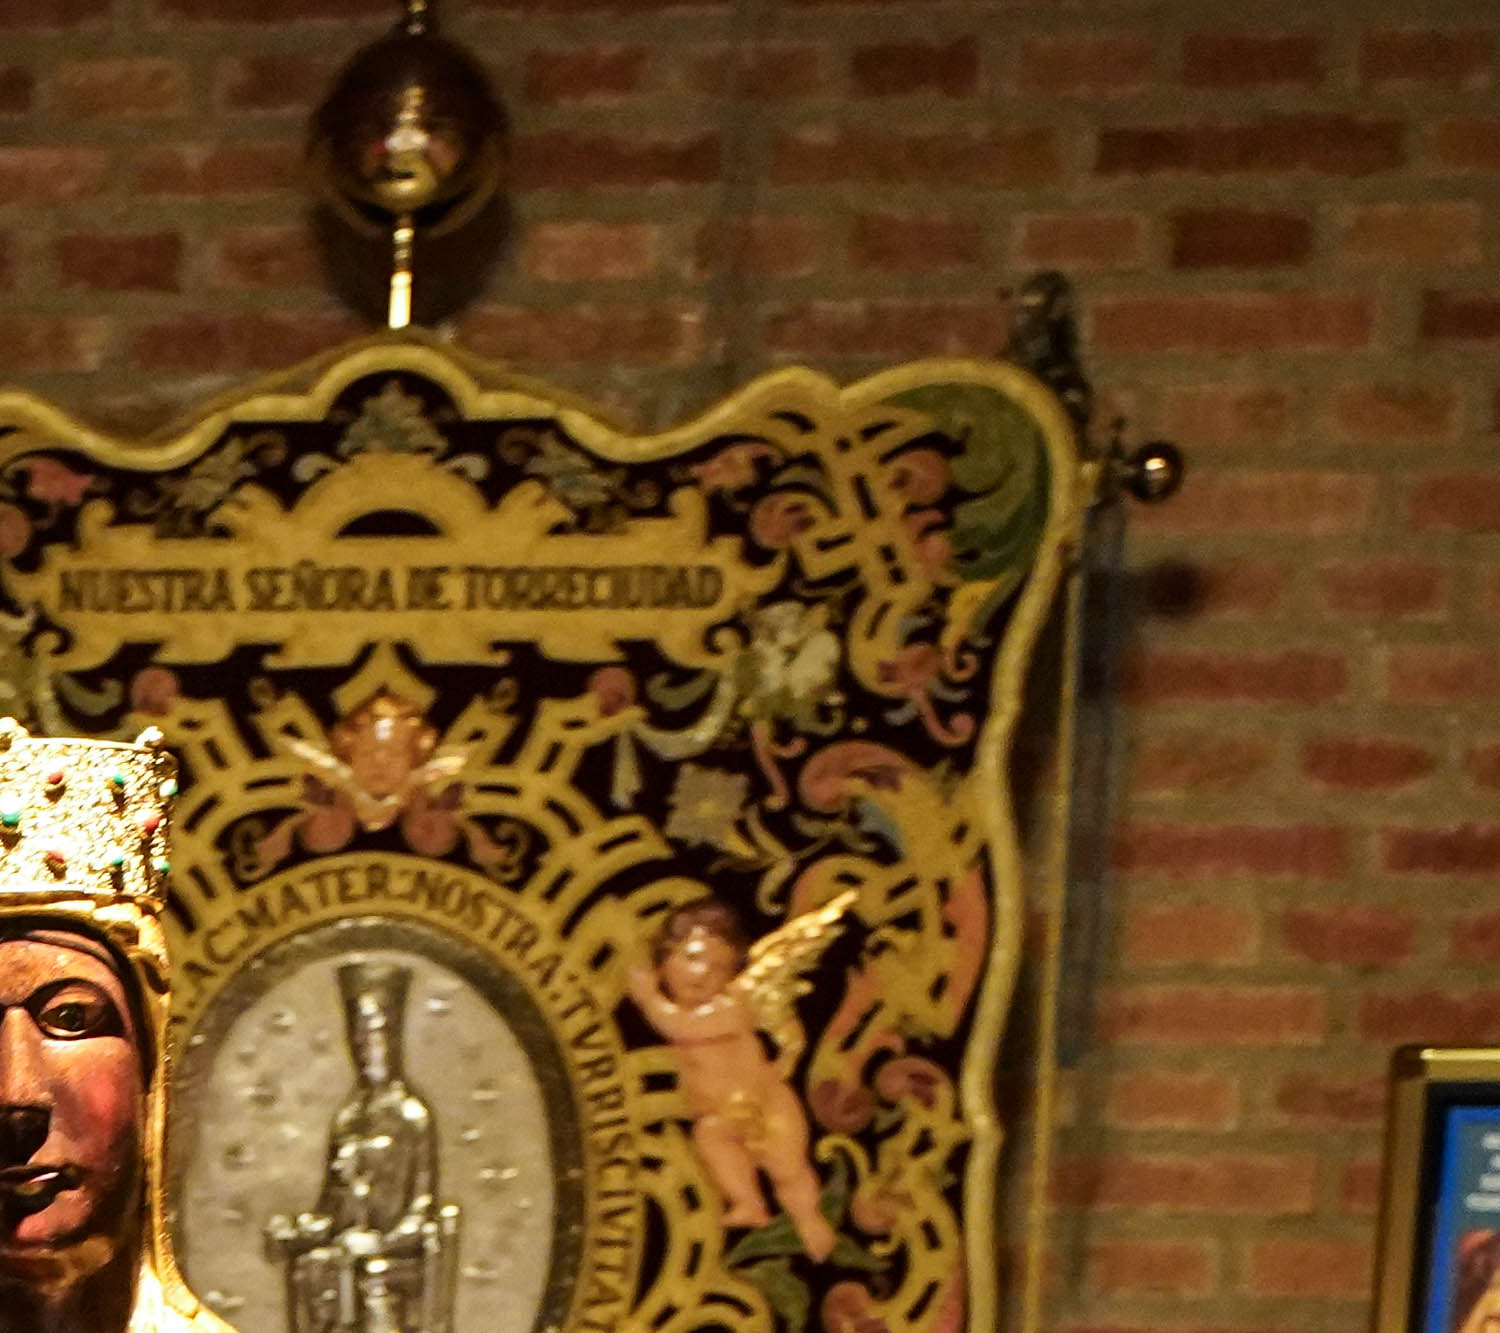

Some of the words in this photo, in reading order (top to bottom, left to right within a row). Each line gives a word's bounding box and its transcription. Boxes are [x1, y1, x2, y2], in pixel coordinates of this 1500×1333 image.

[59, 565, 237, 614] NUESTRA
[244, 558, 396, 613] SEÑORA
[407, 565, 450, 612] DE
[463, 564, 725, 612] TORRECIUDAD
